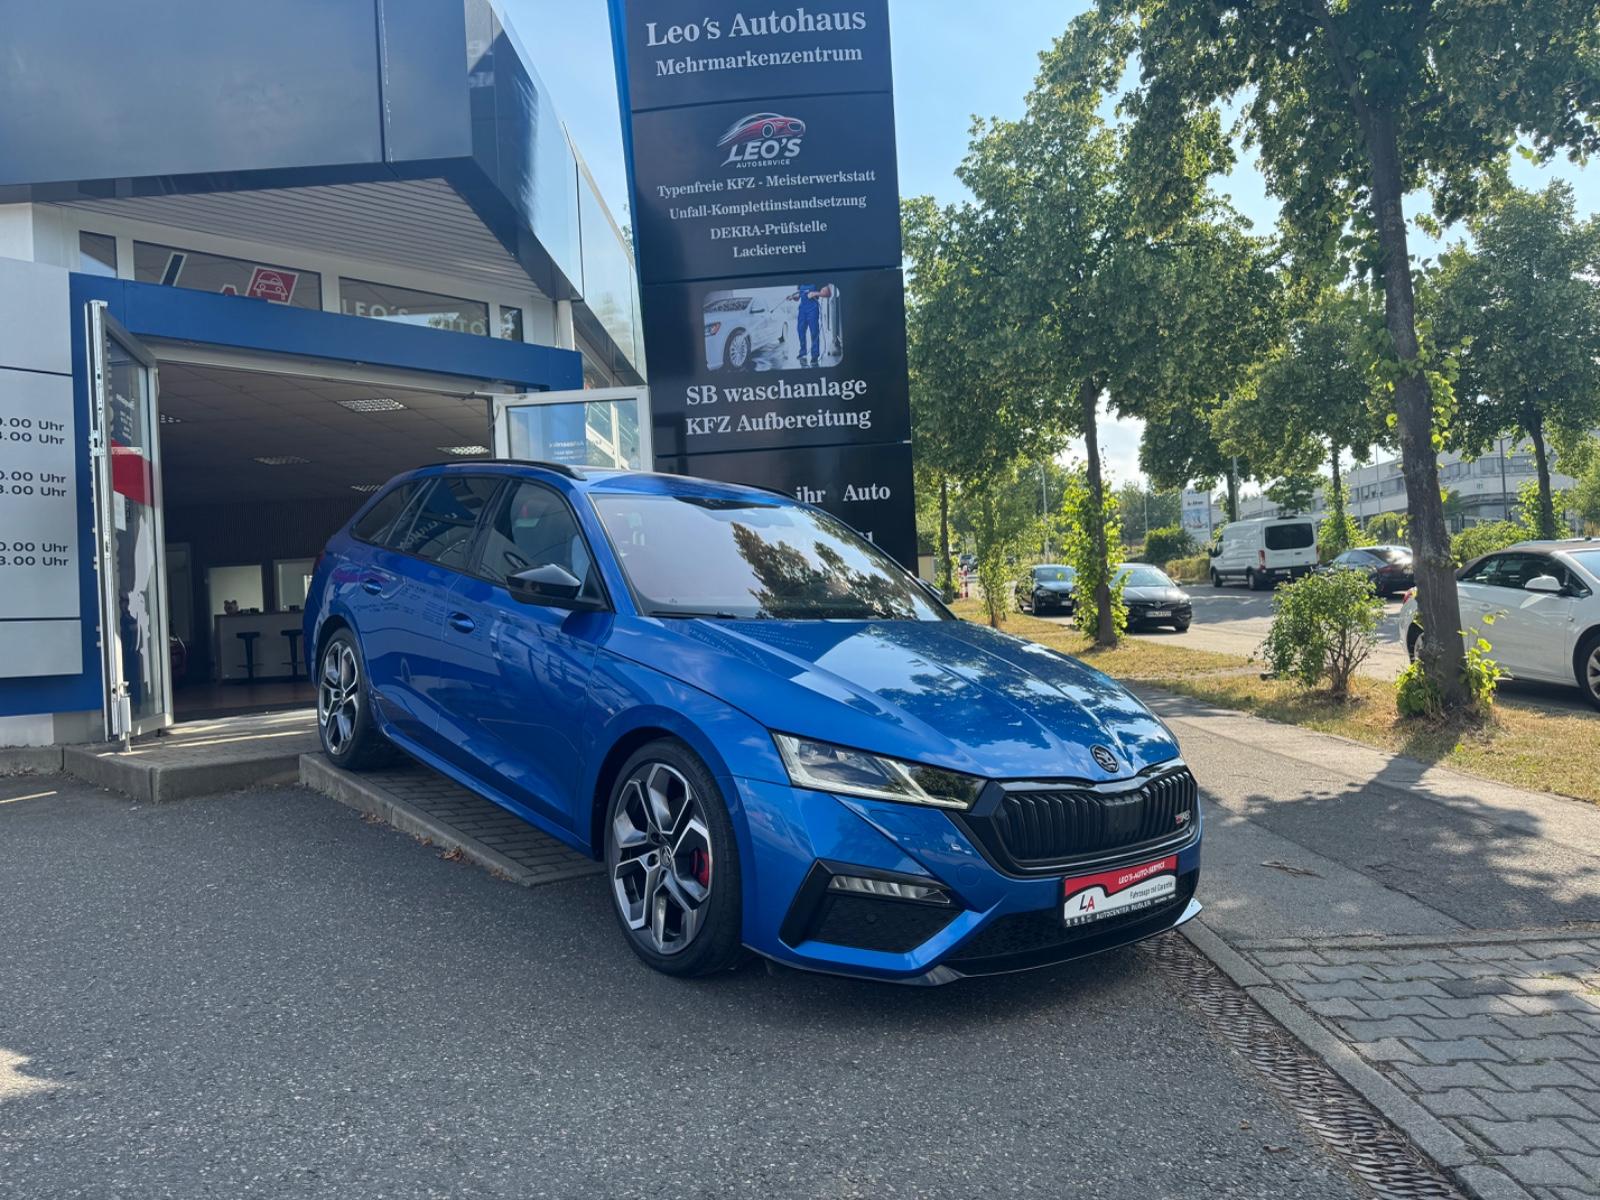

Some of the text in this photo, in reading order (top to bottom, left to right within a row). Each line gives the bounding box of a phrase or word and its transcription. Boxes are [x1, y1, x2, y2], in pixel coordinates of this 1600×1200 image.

[728, 7, 867, 37] Autohaus
[656, 46, 863, 76] Mehrmarkenzentrum
[736, 159, 791, 168] AUTOSERVICE
[657, 179, 724, 199] Typenfreie
[726, 176, 756, 190] KFZ
[765, 170, 876, 187] Meisterwerkstatt
[669, 196, 867, 220] Unfall-Komplettinstandsetzung
[710, 220, 828, 240] DEKRA-Prüfstelle
[733, 241, 807, 258] Lackiererei
[686, 377, 867, 406] SB waschanlage
[0, 417, 65, 431] .00 Uhr
[686, 409, 872, 436] KFZ Aufbereitung
[0, 431, 65, 444] .00 Uhr
[40, 473, 66, 483] Uhr
[40, 486, 67, 497] Uhr
[796, 483, 891, 503] ihr Auto
[42, 543, 69, 552] Uhr
[42, 557, 69, 566] Uhr
